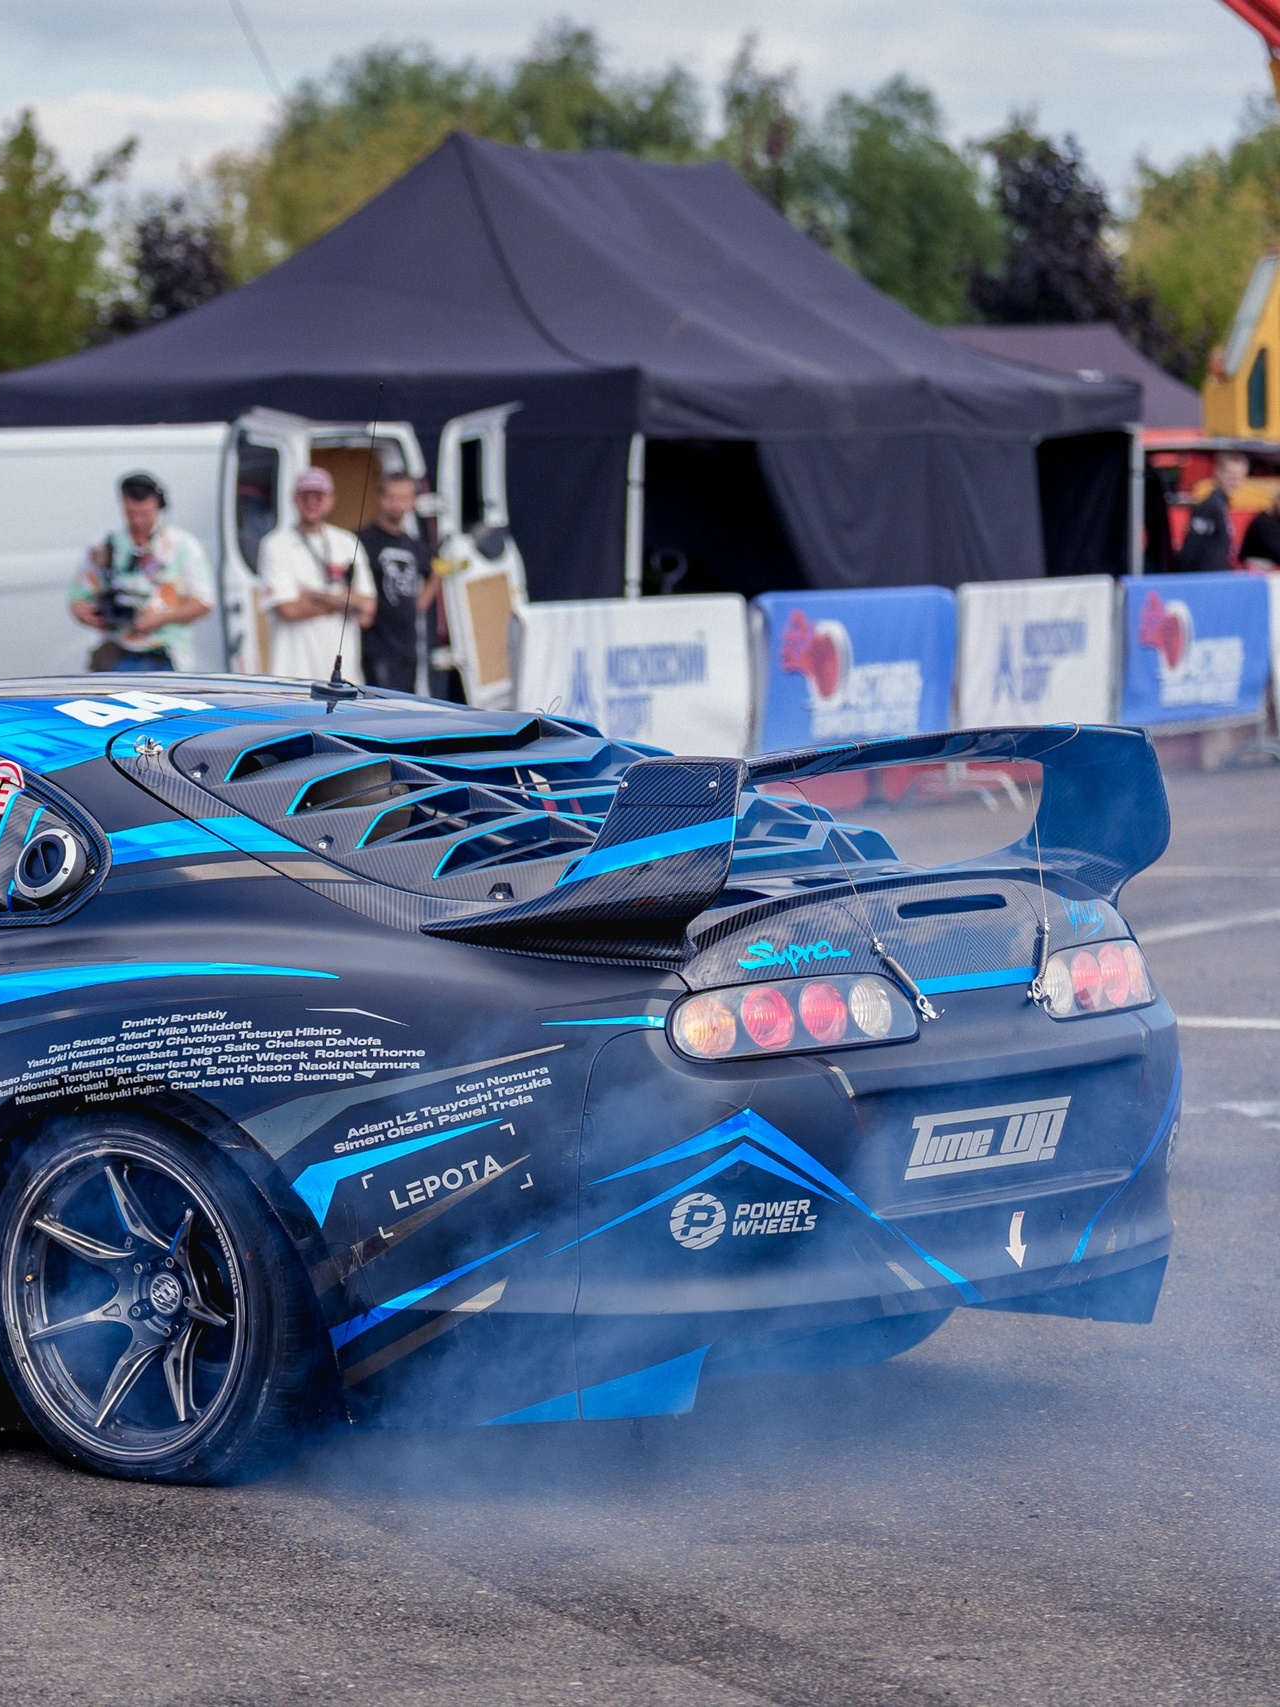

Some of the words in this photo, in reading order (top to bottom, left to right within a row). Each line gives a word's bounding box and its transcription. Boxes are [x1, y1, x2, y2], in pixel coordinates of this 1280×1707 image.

[53, 691, 216, 727] 44
[738, 940, 851, 975] Supra
[48, 1042, 71, 1054] Dan
[72, 1035, 116, 1049] Savage
[119, 1029, 156, 1041] "Mad"
[157, 1026, 187, 1037] Mike
[191, 1020, 252, 1033] Whiddett
[122, 1015, 169, 1029] Dmitriy
[171, 1010, 227, 1023] Brutskiy
[21, 1065, 68, 1082] Suenaga
[71, 1058, 114, 1071] Masato
[116, 1049, 178, 1063] Kawabata
[182, 1045, 221, 1058] Daigo
[225, 1041, 260, 1051] Saito
[265, 1039, 323, 1049] Chelsea
[326, 1036, 381, 1047] DeNofa
[26, 1053, 67, 1069] Yasuyki
[68, 1045, 115, 1060] Kazama
[116, 1036, 163, 1051] Georgy
[166, 1031, 235, 1047] Chivchyan
[239, 1029, 293, 1040] Tetsuya
[295, 1027, 342, 1037] Hibino
[15, 1078, 59, 1093] Holovnia
[61, 1070, 103, 1085] Tengku
[105, 1066, 132, 1079] Djan
[136, 1060, 187, 1072] Charles
[190, 1058, 212, 1068] NG
[218, 1054, 253, 1064] Piotr
[256, 1051, 308, 1063] Więcek
[315, 1049, 367, 1059] Robert
[370, 1048, 425, 1058] Thorne
[15, 1088, 64, 1105] Masanori
[66, 1080, 109, 1095] Kohashi
[116, 1073, 165, 1086] Andrew
[167, 1067, 200, 1080] Gray
[206, 1065, 234, 1076] Ben
[237, 1062, 292, 1074] Hobson
[298, 1061, 340, 1070] Naoki
[343, 1060, 420, 1070] Nakamura
[85, 1086, 131, 1103] Hideyuki
[171, 1079, 220, 1090] Charles
[223, 1076, 244, 1086] NG
[250, 1074, 292, 1084] Naoto
[293, 1071, 354, 1082] Suenaga
[456, 1081, 485, 1094] Ken
[487, 1067, 549, 1086] Nomura
[334, 1132, 385, 1154] Simen
[387, 1120, 434, 1139] Olsen
[438, 1106, 487, 1126] Paweł
[489, 1094, 533, 1112] Trela
[347, 1120, 394, 1139] Adam
[396, 1111, 418, 1125] LZ
[420, 1091, 492, 1118] Tsuyoshi
[494, 1077, 552, 1097] Tezuka
[390, 1155, 503, 1210] LEPOTA
[732, 1215, 818, 1236] WHEELS
[734, 1199, 811, 1219] POWER
[215, 1227, 230, 1259] POWER
